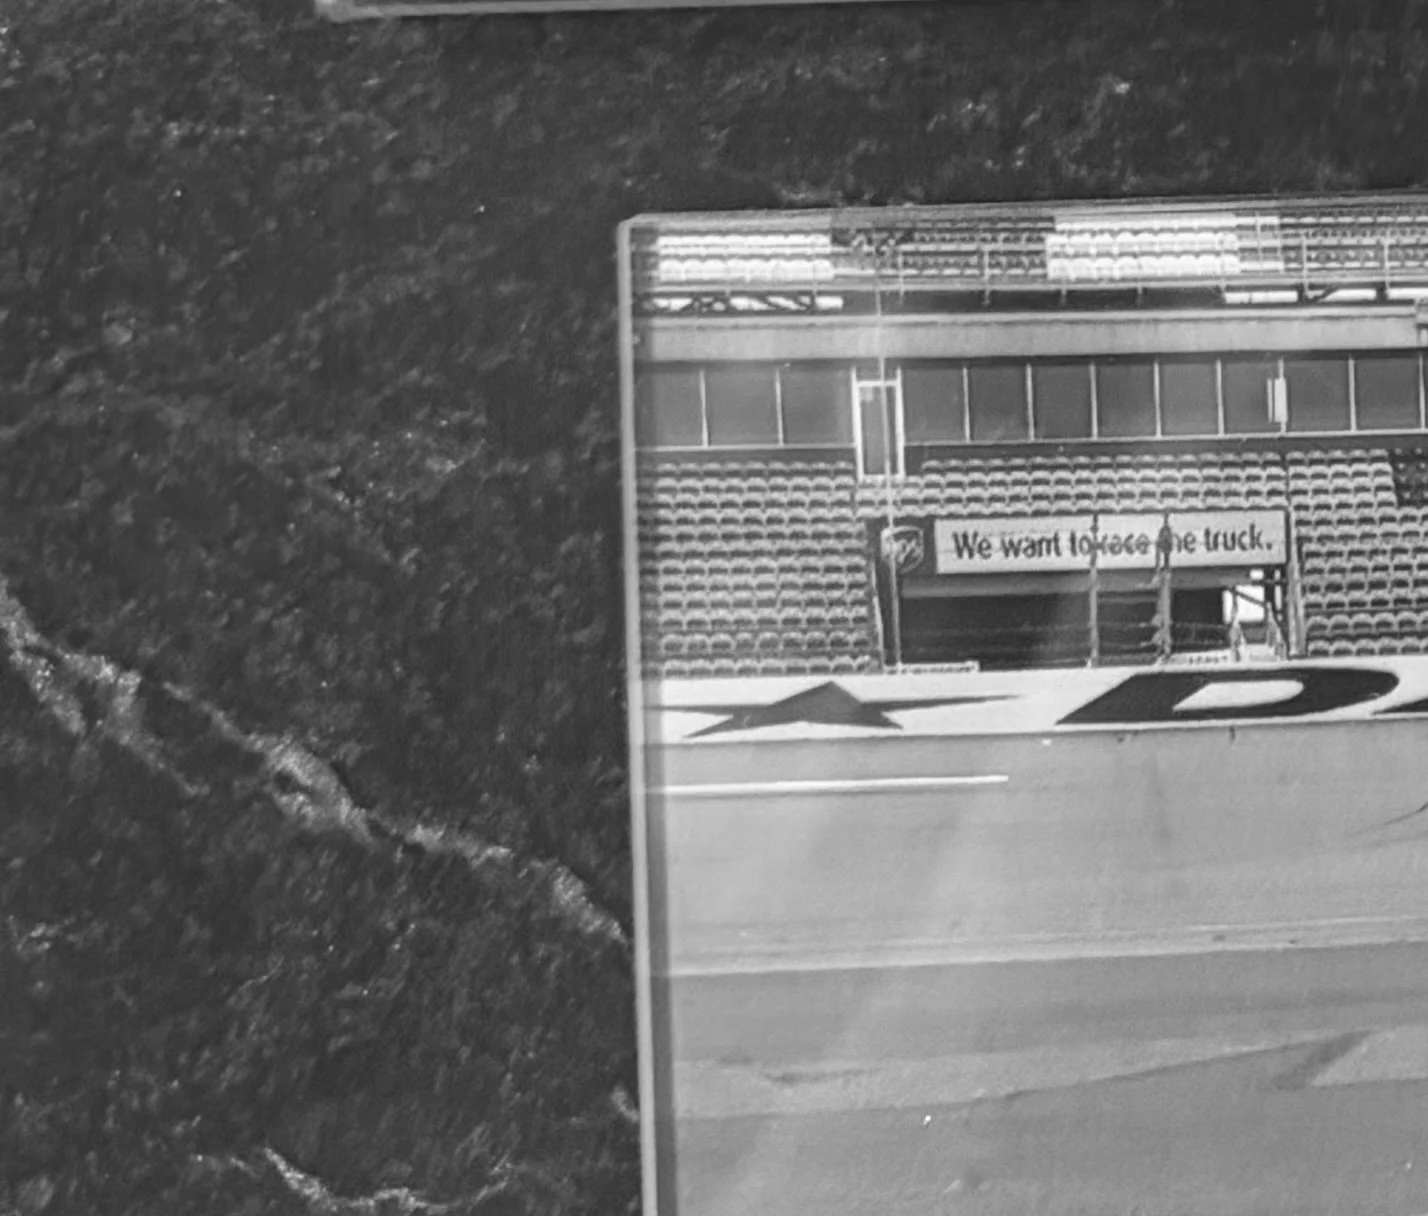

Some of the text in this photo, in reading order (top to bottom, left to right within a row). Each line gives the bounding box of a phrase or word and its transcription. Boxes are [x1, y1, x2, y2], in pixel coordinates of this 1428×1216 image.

[953, 531, 993, 561] We
[1001, 529, 1062, 560] want
[1069, 531, 1094, 557] to
[1204, 521, 1274, 553] truck.
